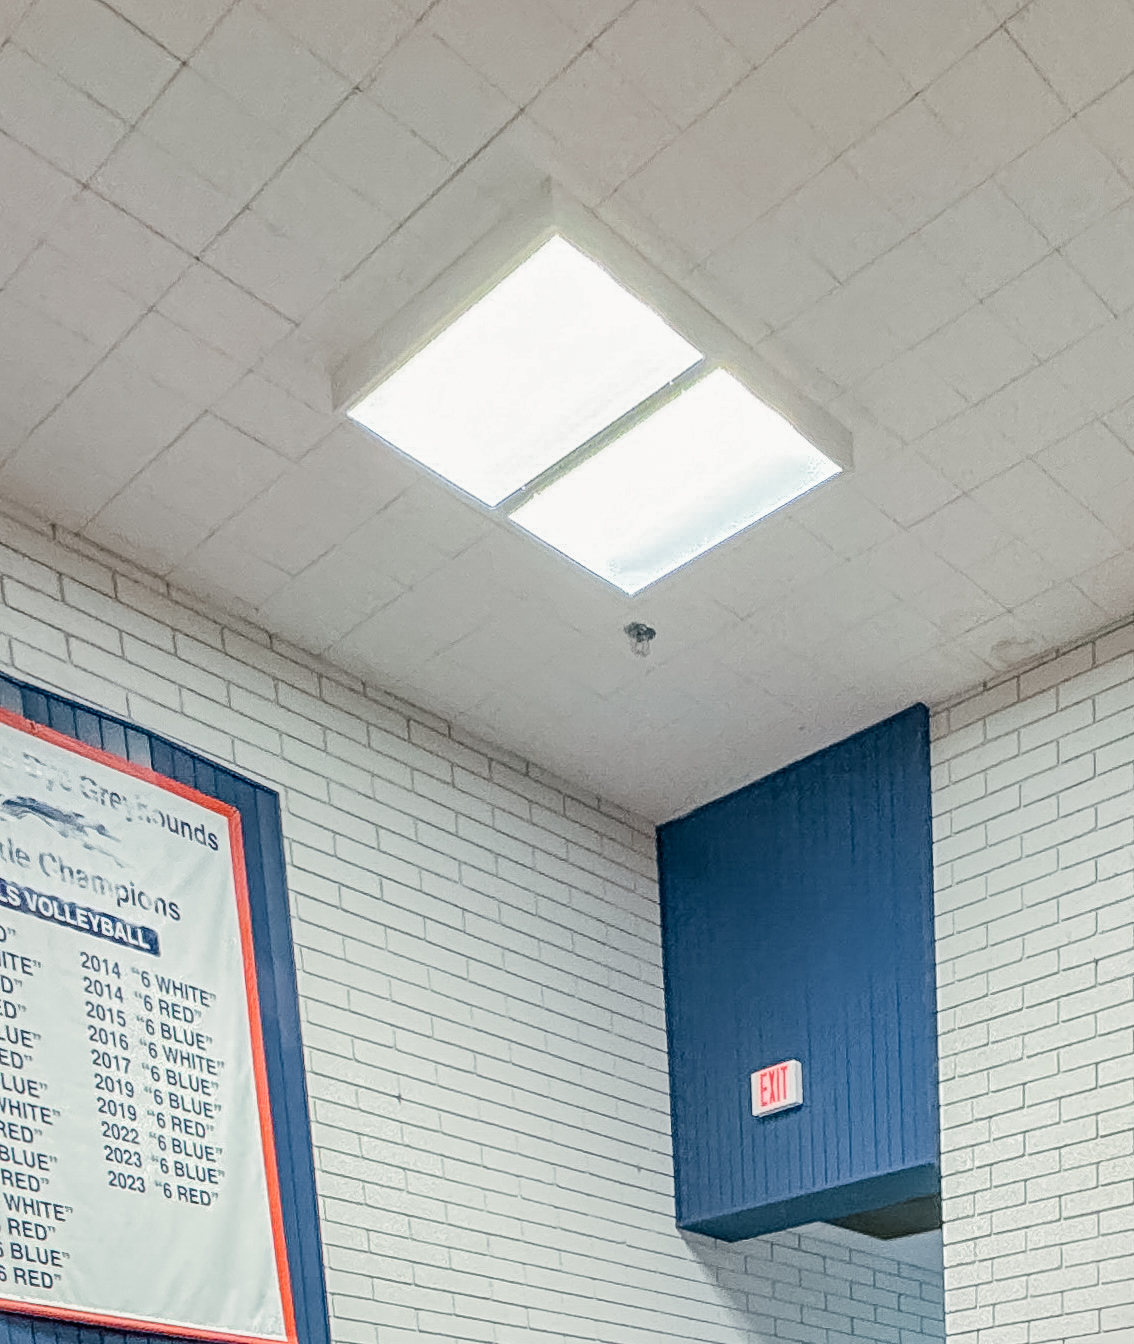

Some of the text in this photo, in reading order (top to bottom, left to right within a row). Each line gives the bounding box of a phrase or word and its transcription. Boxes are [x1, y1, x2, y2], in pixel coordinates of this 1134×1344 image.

[80, 775, 218, 851] Greounds
[39, 852, 181, 921] Champions
[24, 890, 151, 950] VOLLEYBALL
[0, 951, 42, 976] ITE”
[80, 952, 121, 979] 2014
[155, 974, 216, 1008] WHITE”
[0, 1000, 27, 1019] D”
[83, 976, 123, 1003] 2014
[158, 998, 201, 1024] RED”
[85, 1001, 126, 1027] 2015
[160, 1022, 213, 1051] BLUE”
[88, 1025, 129, 1051] 2016
[162, 1045, 225, 1076] WHITE”
[91, 1049, 131, 1074] 2017
[166, 1068, 219, 1097] BLUE”
[759, 1065, 788, 1107] EXIT
[94, 1073, 134, 1098] 2019
[168, 1092, 222, 1119] BLUE”
[96, 1096, 136, 1121] 2019
[171, 1115, 214, 1138] RED”
[101, 1120, 140, 1145] 2022
[171, 1137, 223, 1163] BLUE”
[1, 1168, 50, 1192] RED”
[104, 1145, 142, 1168] 2023
[174, 1160, 225, 1184] BLUE”
[3, 1192, 73, 1222] WHITE”
[107, 1170, 145, 1193] 2023
[177, 1185, 219, 1206] RED”
[7, 1217, 56, 1241] RED”
[10, 1242, 70, 1268] BLUE”
[13, 1267, 62, 1289] RED”
